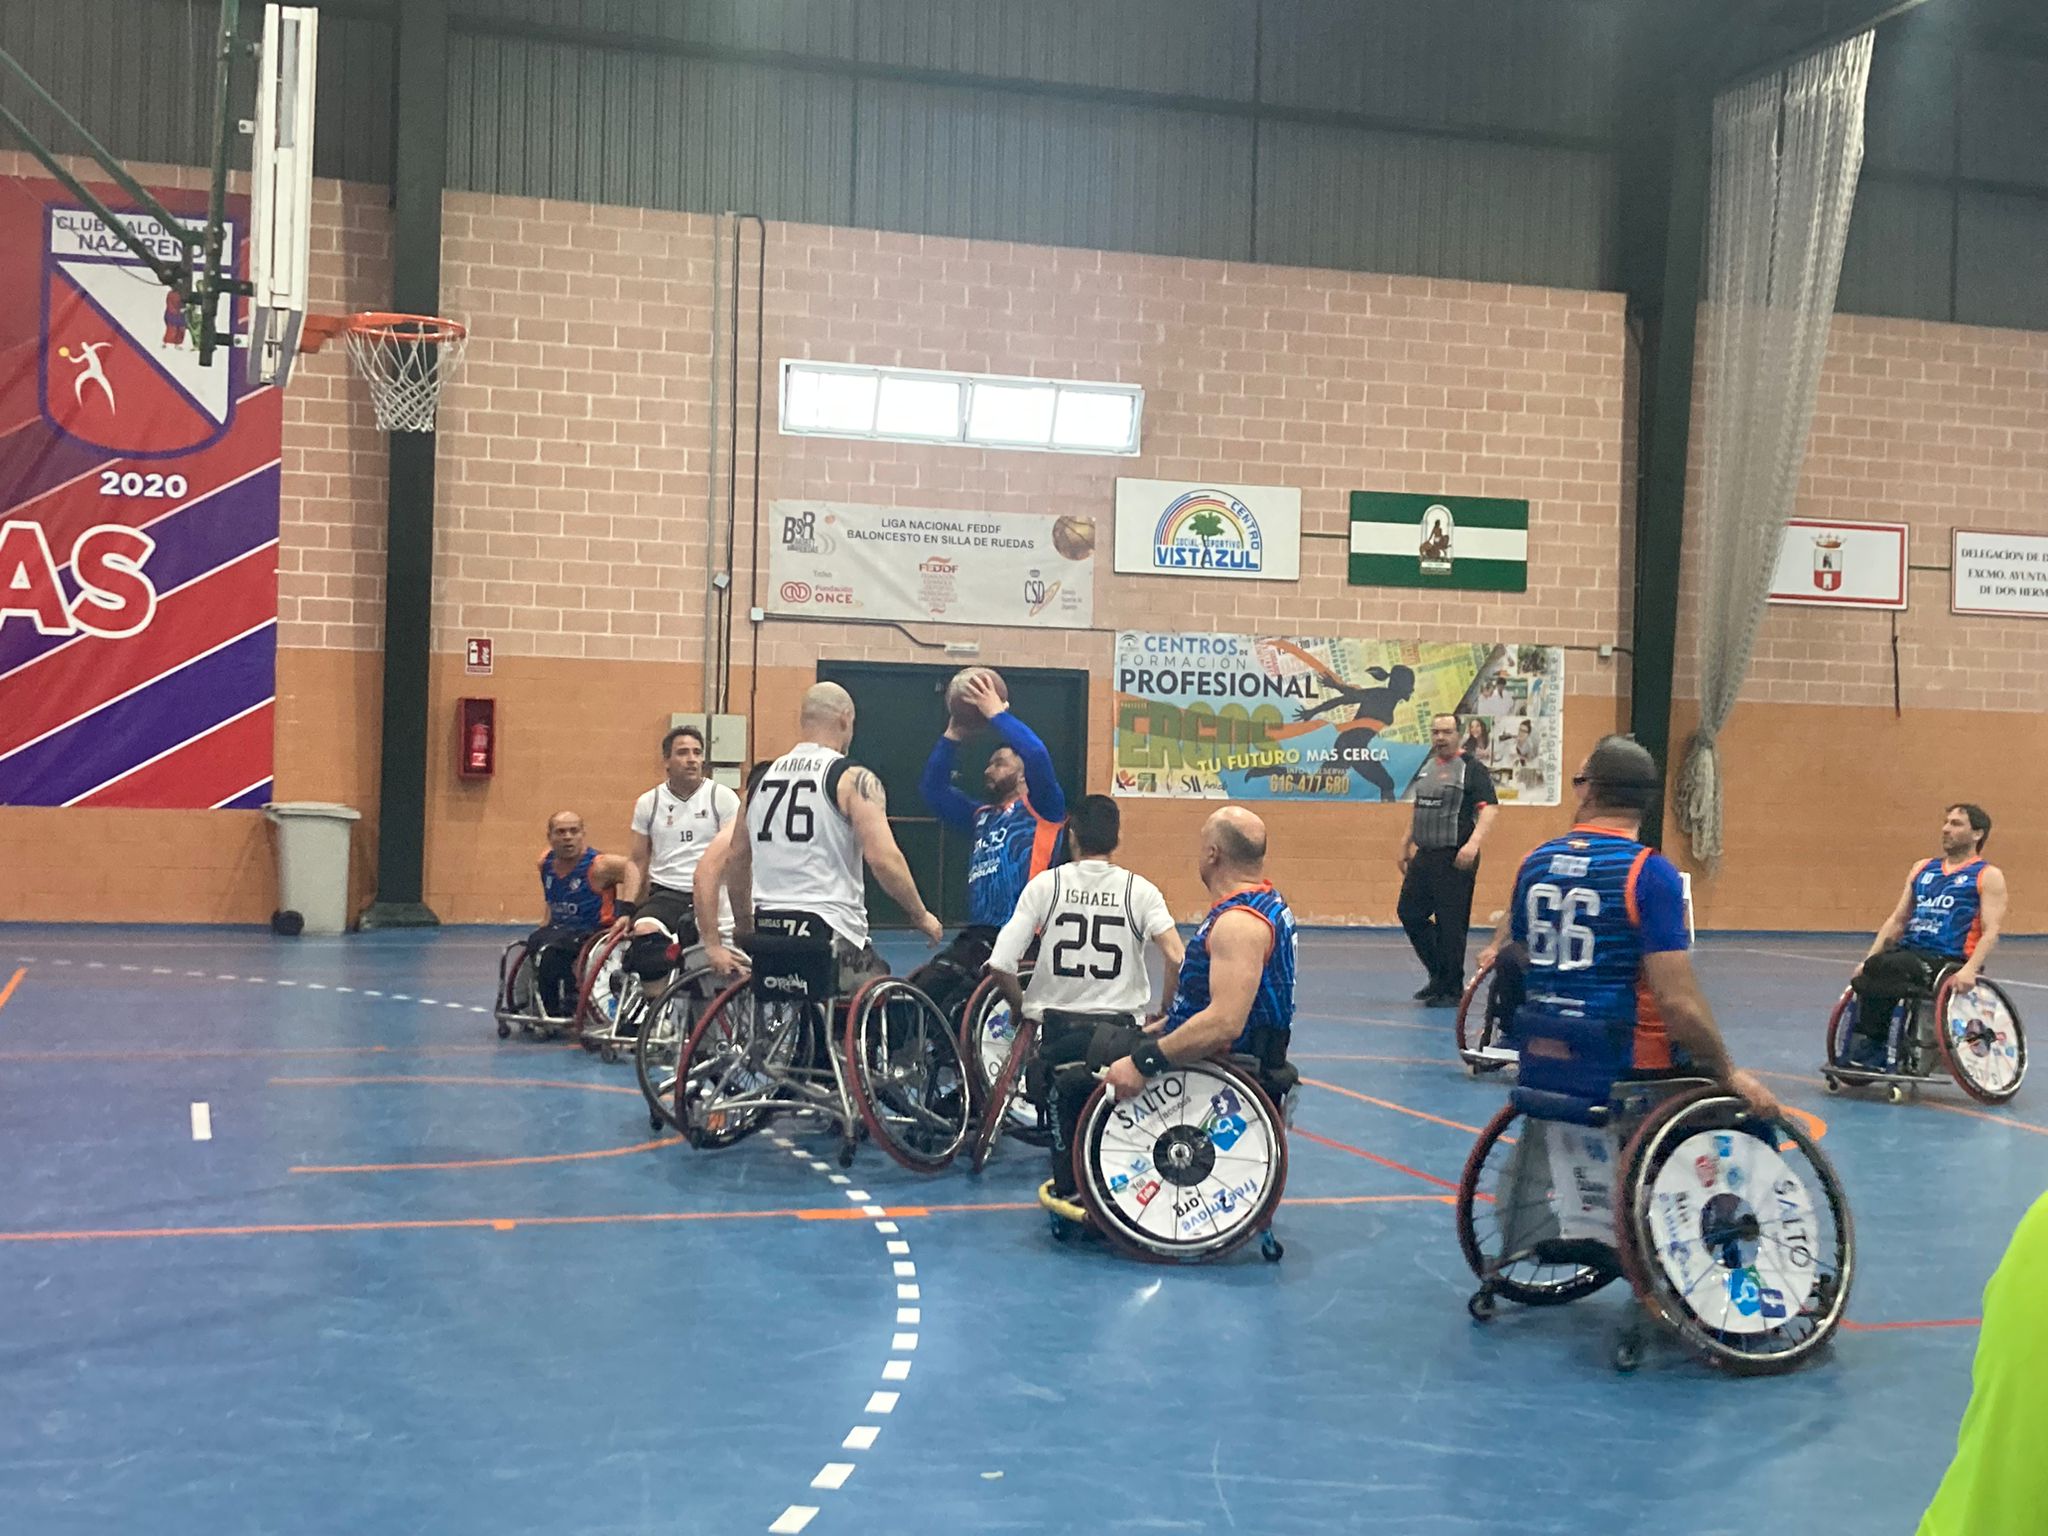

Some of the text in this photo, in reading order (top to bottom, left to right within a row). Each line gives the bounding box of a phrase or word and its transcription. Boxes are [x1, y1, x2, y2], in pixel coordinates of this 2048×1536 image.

[56, 216, 106, 232] CLUB
[100, 471, 188, 498] 2020
[881, 519, 907, 529] LIGA
[909, 521, 965, 532] NACIONAL
[1230, 501, 1260, 550] CENTRO
[847, 530, 1035, 549] BALONCESTO EN SILLA DE RUEDAS
[1157, 547, 1259, 569] VISTAZUL
[815, 593, 853, 604] ONCE
[1995, 586, 2017, 596] DOS
[1144, 636, 1238, 656] CENTROS
[1120, 668, 1319, 699] PROFESIONAL
[774, 757, 823, 772] VARGAS
[1198, 759, 1221, 774] TU
[1227, 751, 1300, 771] FUTURO
[1343, 748, 1389, 761] CERCA
[1298, 775, 1321, 793] 477
[757, 779, 817, 842] 76
[680, 830, 693, 842] 18
[1065, 888, 1119, 907] ISRAEL
[1527, 882, 1601, 971] 66
[1053, 912, 1125, 980] 25
[1117, 1077, 1183, 1129] SALTO
[1774, 1179, 1812, 1267] SALTO
